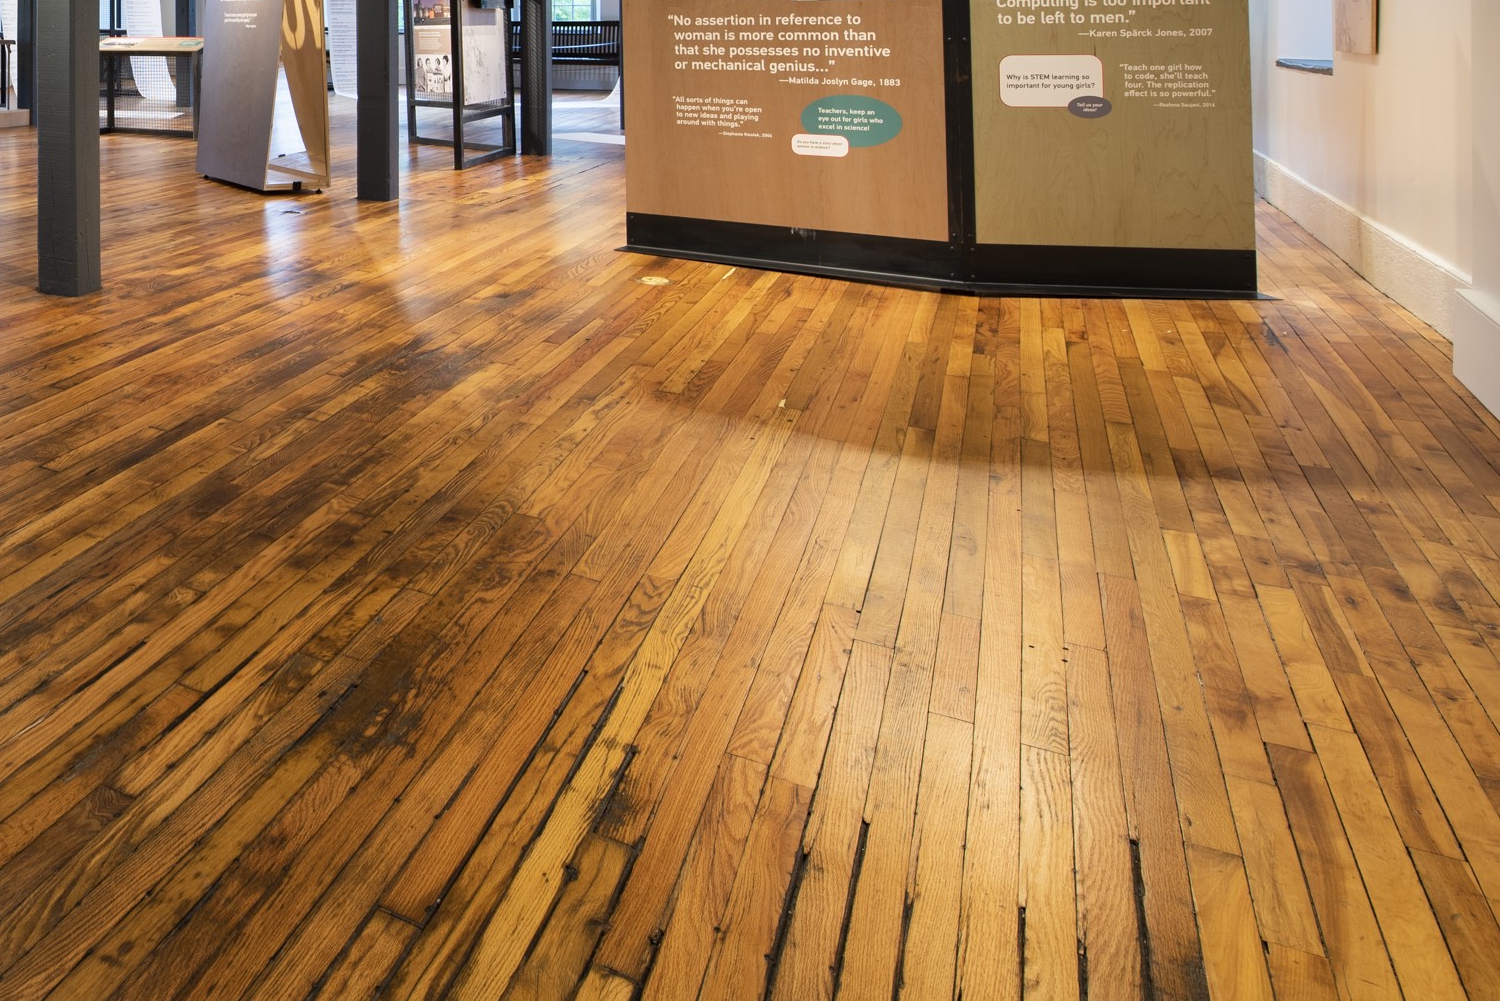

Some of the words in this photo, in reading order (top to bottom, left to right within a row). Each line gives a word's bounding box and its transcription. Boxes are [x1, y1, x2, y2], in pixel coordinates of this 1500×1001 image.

[695, 14, 755, 26] assertion
[759, 14, 771, 25] in
[776, 13, 842, 25] reference
[847, 14, 861, 25] to
[997, 14, 1012, 24] to
[1017, 12, 1036, 24] be
[1041, 11, 1065, 24] left
[1070, 12, 1085, 24] to
[674, 32, 720, 40] woman
[725, 29, 735, 40] is
[740, 32, 774, 41] more
[778, 32, 839, 41] common
[844, 29, 876, 41] than
[1120, 29, 1153, 39] Spärck
[1155, 28, 1187, 38] Jones,
[1189, 28, 1213, 37] 2007
[675, 44, 699, 55] that
[703, 44, 726, 55] she
[730, 47, 799, 58] possesses
[803, 48, 820, 56] no
[825, 45, 891, 57] inventive
[675, 61, 688, 70] or
[692, 59, 766, 71] mechanical
[1167, 63, 1183, 73] girl
[1051, 74, 1080, 82] learning
[1134, 72, 1158, 81] code,
[821, 78, 849, 87] Joslyn
[851, 78, 876, 88] Gage,
[1075, 82, 1095, 90] girls?
[1124, 81, 1144, 89] four.
[1146, 81, 1162, 89] The
[1164, 81, 1209, 90] replication
[1124, 89, 1148, 97] effect
